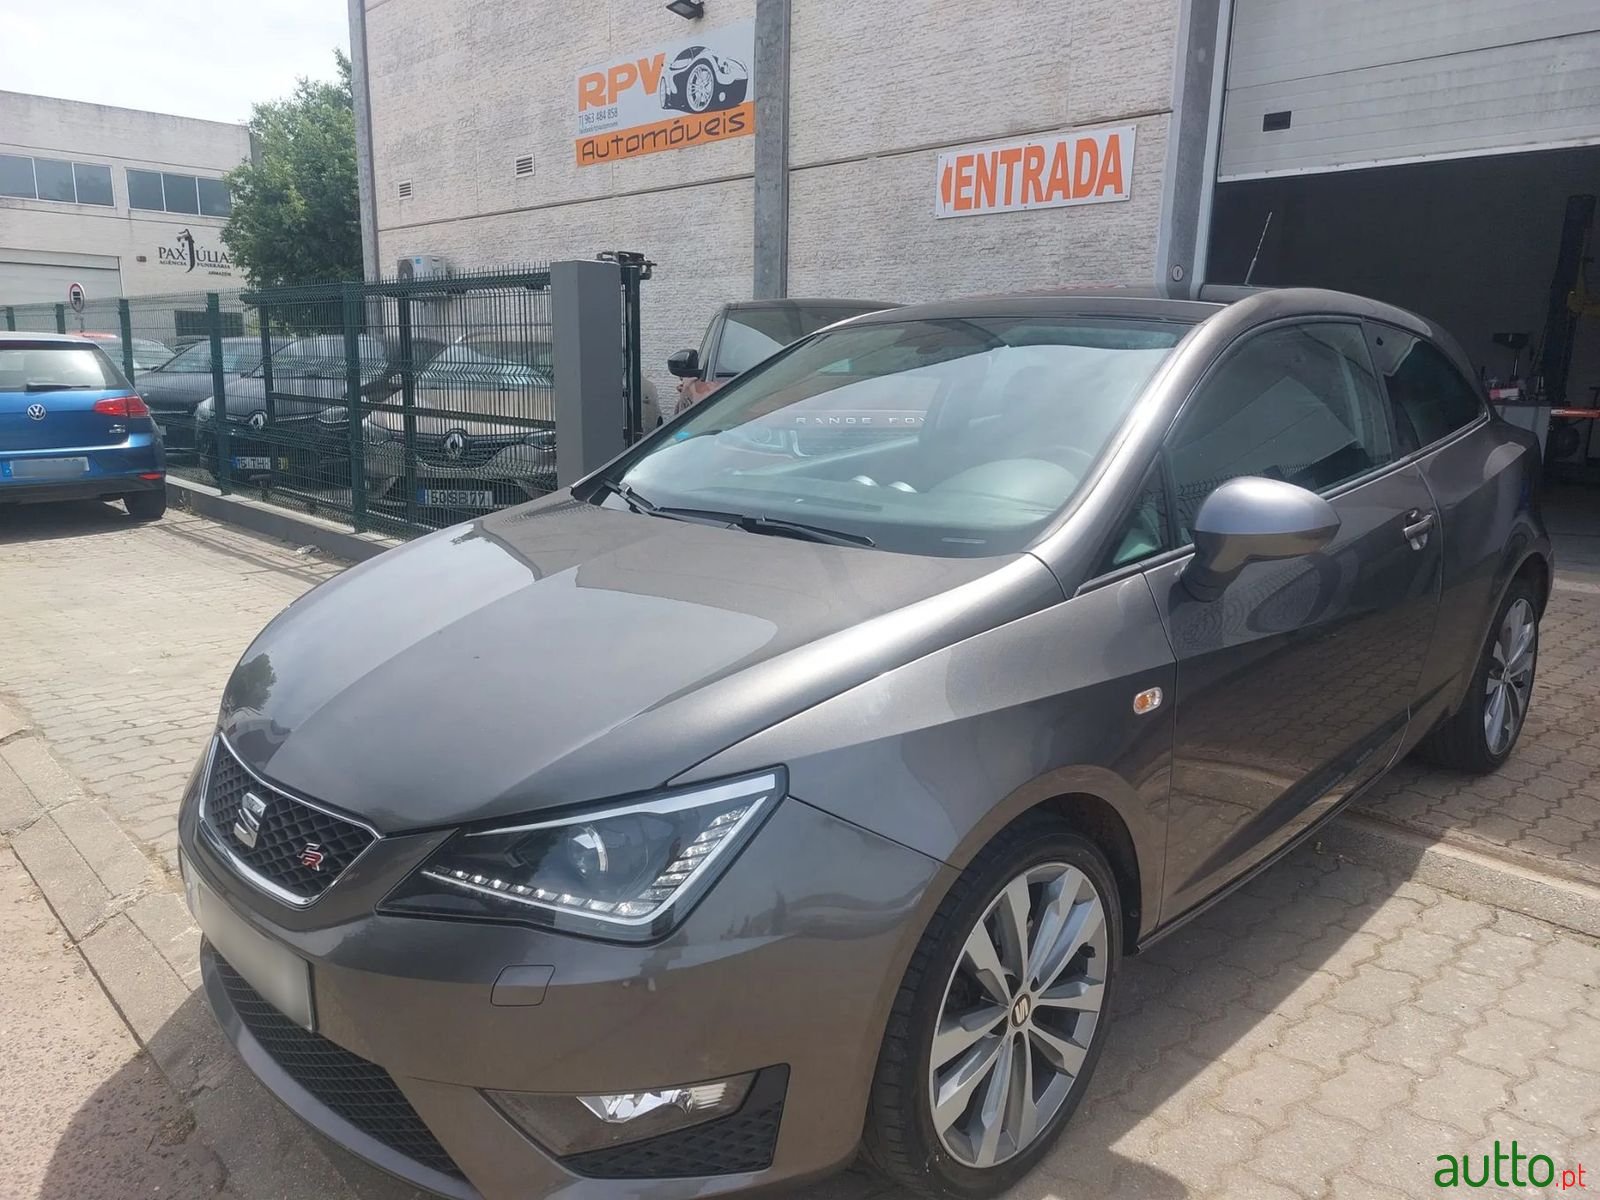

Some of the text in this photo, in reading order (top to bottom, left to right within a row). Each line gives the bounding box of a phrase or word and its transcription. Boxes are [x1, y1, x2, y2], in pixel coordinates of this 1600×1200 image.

[578, 53, 665, 112] RPV
[582, 111, 745, 161] Automóveis
[953, 134, 1124, 212] ENTRADA
[796, 416, 873, 425] RANGE
